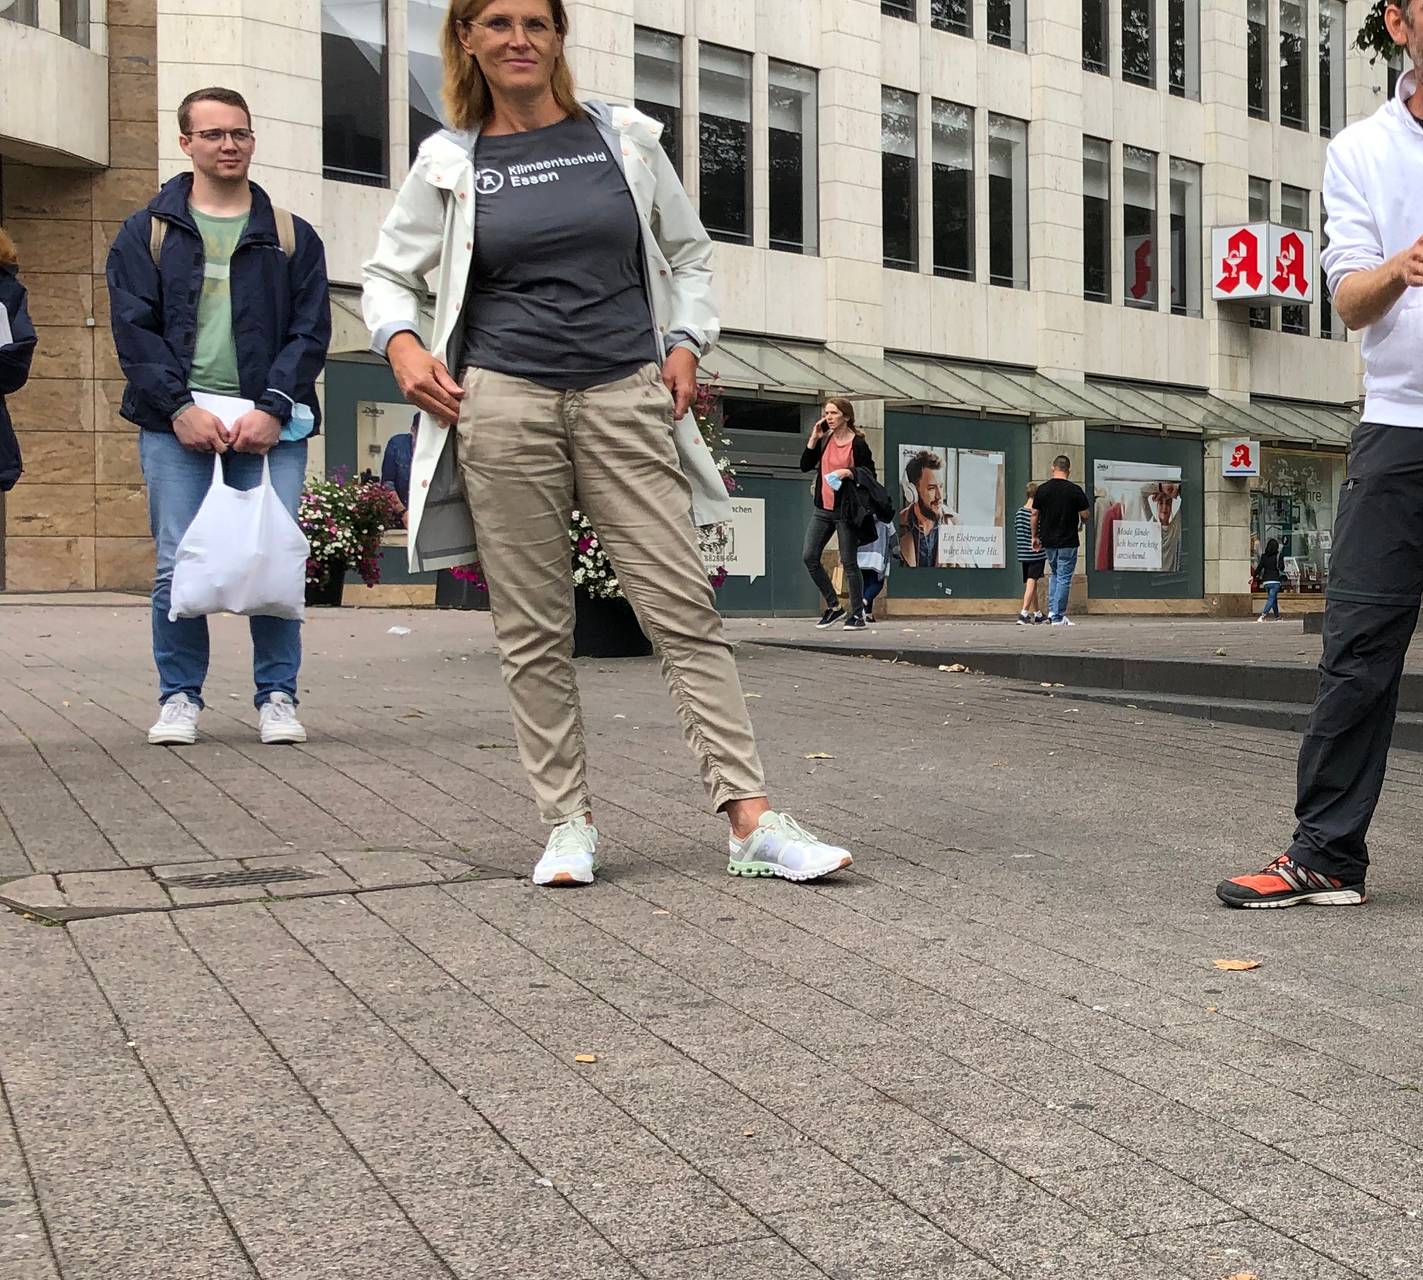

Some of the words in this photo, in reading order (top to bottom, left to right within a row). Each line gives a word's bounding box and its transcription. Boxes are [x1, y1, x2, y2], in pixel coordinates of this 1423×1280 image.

[507, 152, 608, 176] Klimaentscheid
[509, 171, 560, 188] Essen
[1117, 527, 1134, 536] Mode
[943, 533, 955, 543] Ein
[956, 533, 998, 543] Elektromarkt
[960, 546, 974, 556] hier
[975, 546, 986, 556] der
